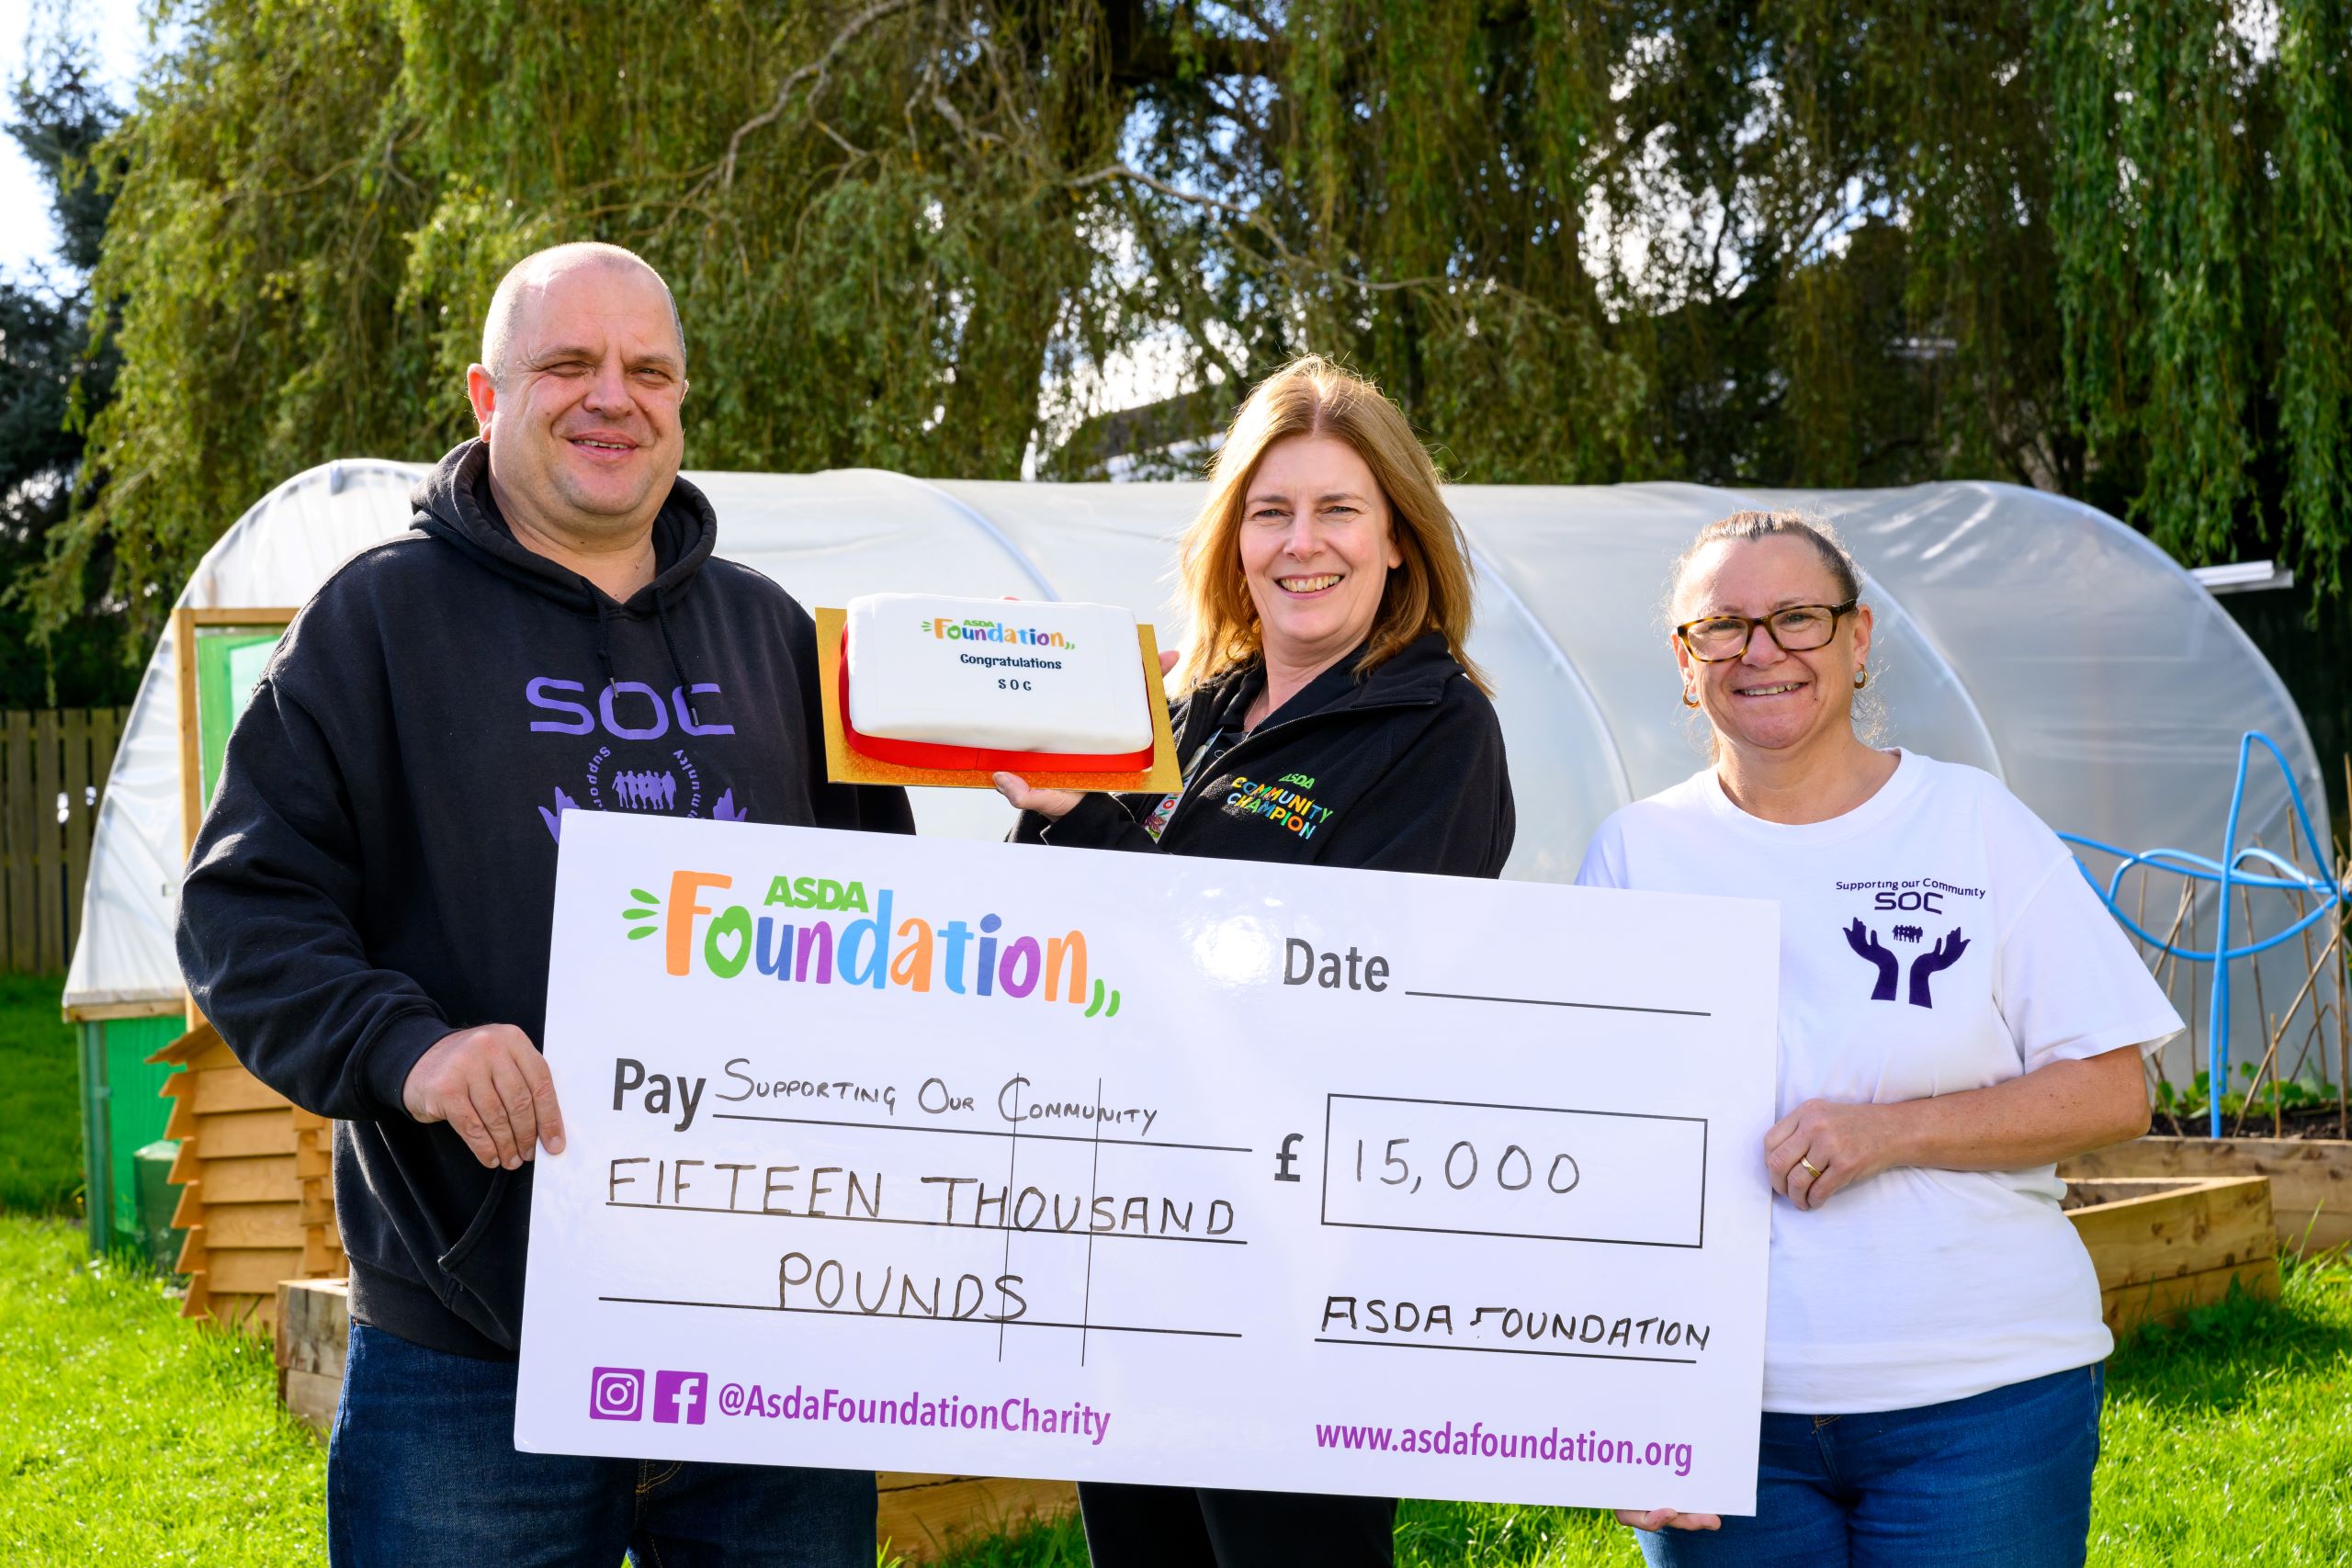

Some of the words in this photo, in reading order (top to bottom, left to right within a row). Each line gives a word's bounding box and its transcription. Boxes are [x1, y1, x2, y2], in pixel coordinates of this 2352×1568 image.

[933, 618, 1065, 648] Foundation
[963, 619, 995, 628] ASDA
[960, 653, 1062, 670] Congratulations
[526, 676, 735, 740] SOC
[586, 746, 611, 812] Suppor
[1231, 776, 1333, 824] COMMUNITY
[1278, 773, 1316, 790] ASDA
[1227, 792, 1317, 840] CHAMPION
[763, 875, 869, 913] ASDA
[1836, 879, 1899, 891] Supporting
[1901, 879, 1921, 889] our
[1922, 877, 1986, 899] Community
[1873, 891, 1944, 915] SOC
[665, 870, 1088, 1004] Foundation
[1283, 937, 1390, 993] Date
[612, 1057, 707, 1132] Pay
[1273, 1133, 1305, 1183] £
[1357, 1137, 1580, 1194] 15,000
[608, 1157, 882, 1218] FIFTEEN
[921, 1176, 1235, 1236] THOUSAND
[778, 1252, 1028, 1321] POUNDS
[1321, 1295, 1453, 1336] ASDA
[718, 1382, 1111, 1445] @AsdaFoundationCharity
[1316, 1421, 1693, 1476] www.asdafoundation.org
